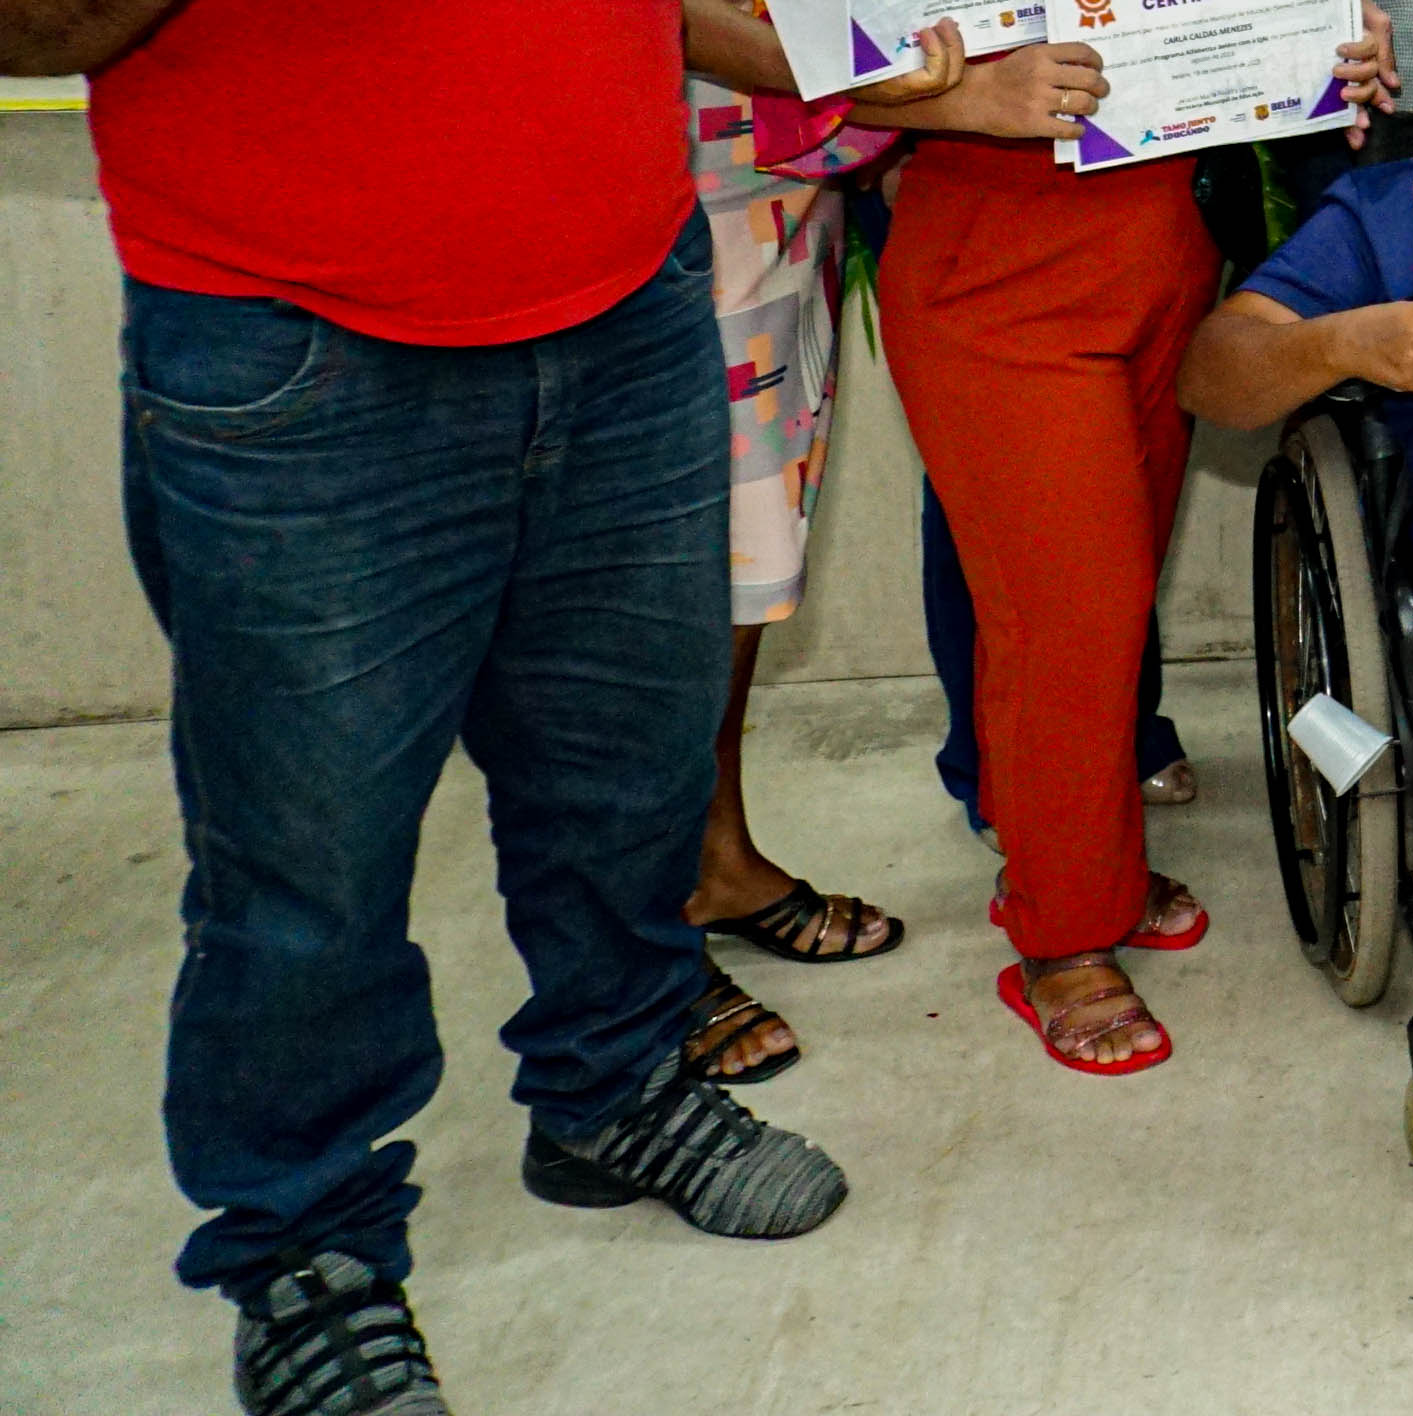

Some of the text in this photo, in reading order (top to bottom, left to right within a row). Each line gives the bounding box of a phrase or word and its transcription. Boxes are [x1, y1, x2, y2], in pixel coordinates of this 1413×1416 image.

[1163, 23, 1253, 45] CARLA CALDAS MENEZES
